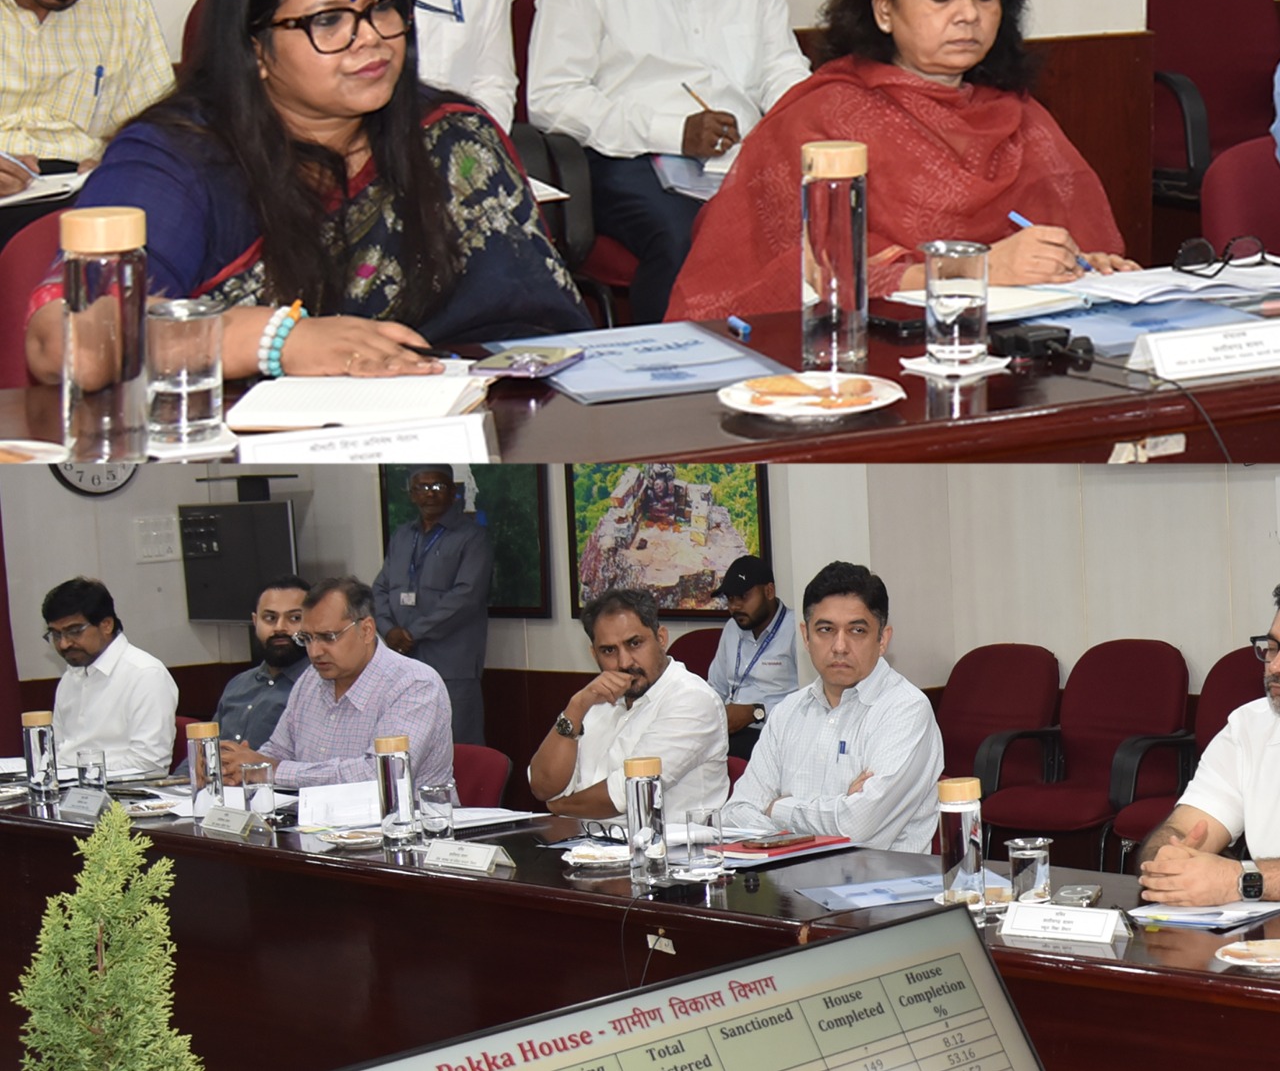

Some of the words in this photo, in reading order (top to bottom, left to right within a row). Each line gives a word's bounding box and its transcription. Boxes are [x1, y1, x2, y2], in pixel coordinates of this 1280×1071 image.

[76, 470, 84, 483] 7
[91, 474, 101, 486] 6
[106, 470, 116, 481] 5
[905, 965, 943, 986] House
[822, 988, 864, 1010] House
[898, 978, 967, 1009] Completion
[517, 1030, 593, 1063] House
[609, 1008, 666, 1036] ग्रामीण
[668, 990, 726, 1020] विकास
[728, 975, 778, 1004] विभाग
[817, 1002, 886, 1033] Completed
[933, 1005, 949, 1018] %
[719, 1008, 794, 1040] Sanctioned
[645, 1039, 686, 1062] Total
[942, 1032, 966, 1048] 8.12
[947, 1048, 976, 1066] 53.16
